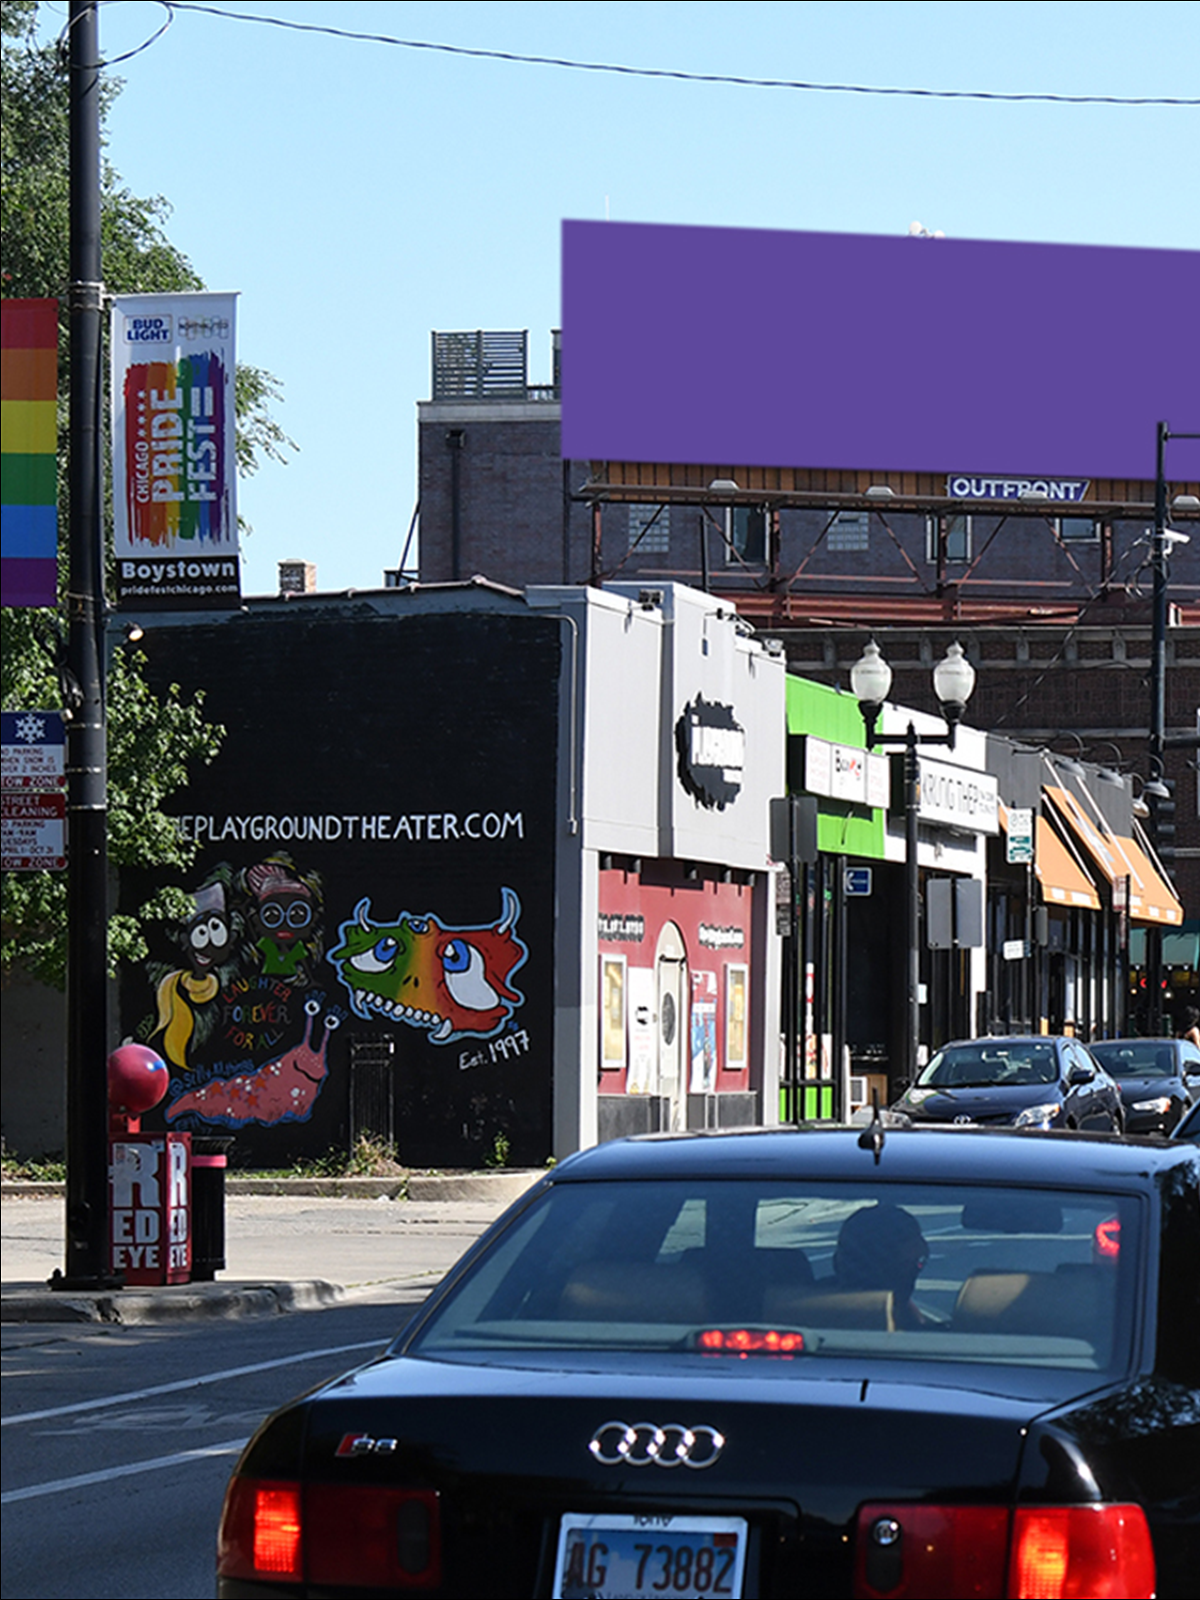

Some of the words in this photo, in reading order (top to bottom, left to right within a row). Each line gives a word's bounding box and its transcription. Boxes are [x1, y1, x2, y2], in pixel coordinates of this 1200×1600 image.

[127, 329, 169, 341] LIGHT
[132, 318, 164, 330] BUD
[150, 387, 184, 502] PRIDE
[135, 441, 150, 503] CHICAGO
[952, 478, 1081, 500] OUTFRONT
[121, 561, 235, 583] Boystown
[120, 584, 239, 596] pridefestchicago.com
[1, 765, 18, 773] VER
[1, 776, 22, 788] OW
[28, 776, 58, 788] ZONE
[1, 857, 22, 868] OW
[28, 857, 58, 868] ZONE
[222, 976, 292, 1003] LAUGHTER
[222, 1001, 291, 1024] FOREVER
[225, 1026, 255, 1050] FOR
[257, 1028, 285, 1050] ALL
[459, 1050, 489, 1070] Est.
[489, 1029, 530, 1063] 1997
[112, 1245, 160, 1268] EYE
[169, 1244, 187, 1268] EYE
[634, 1543, 735, 1594] 73882
